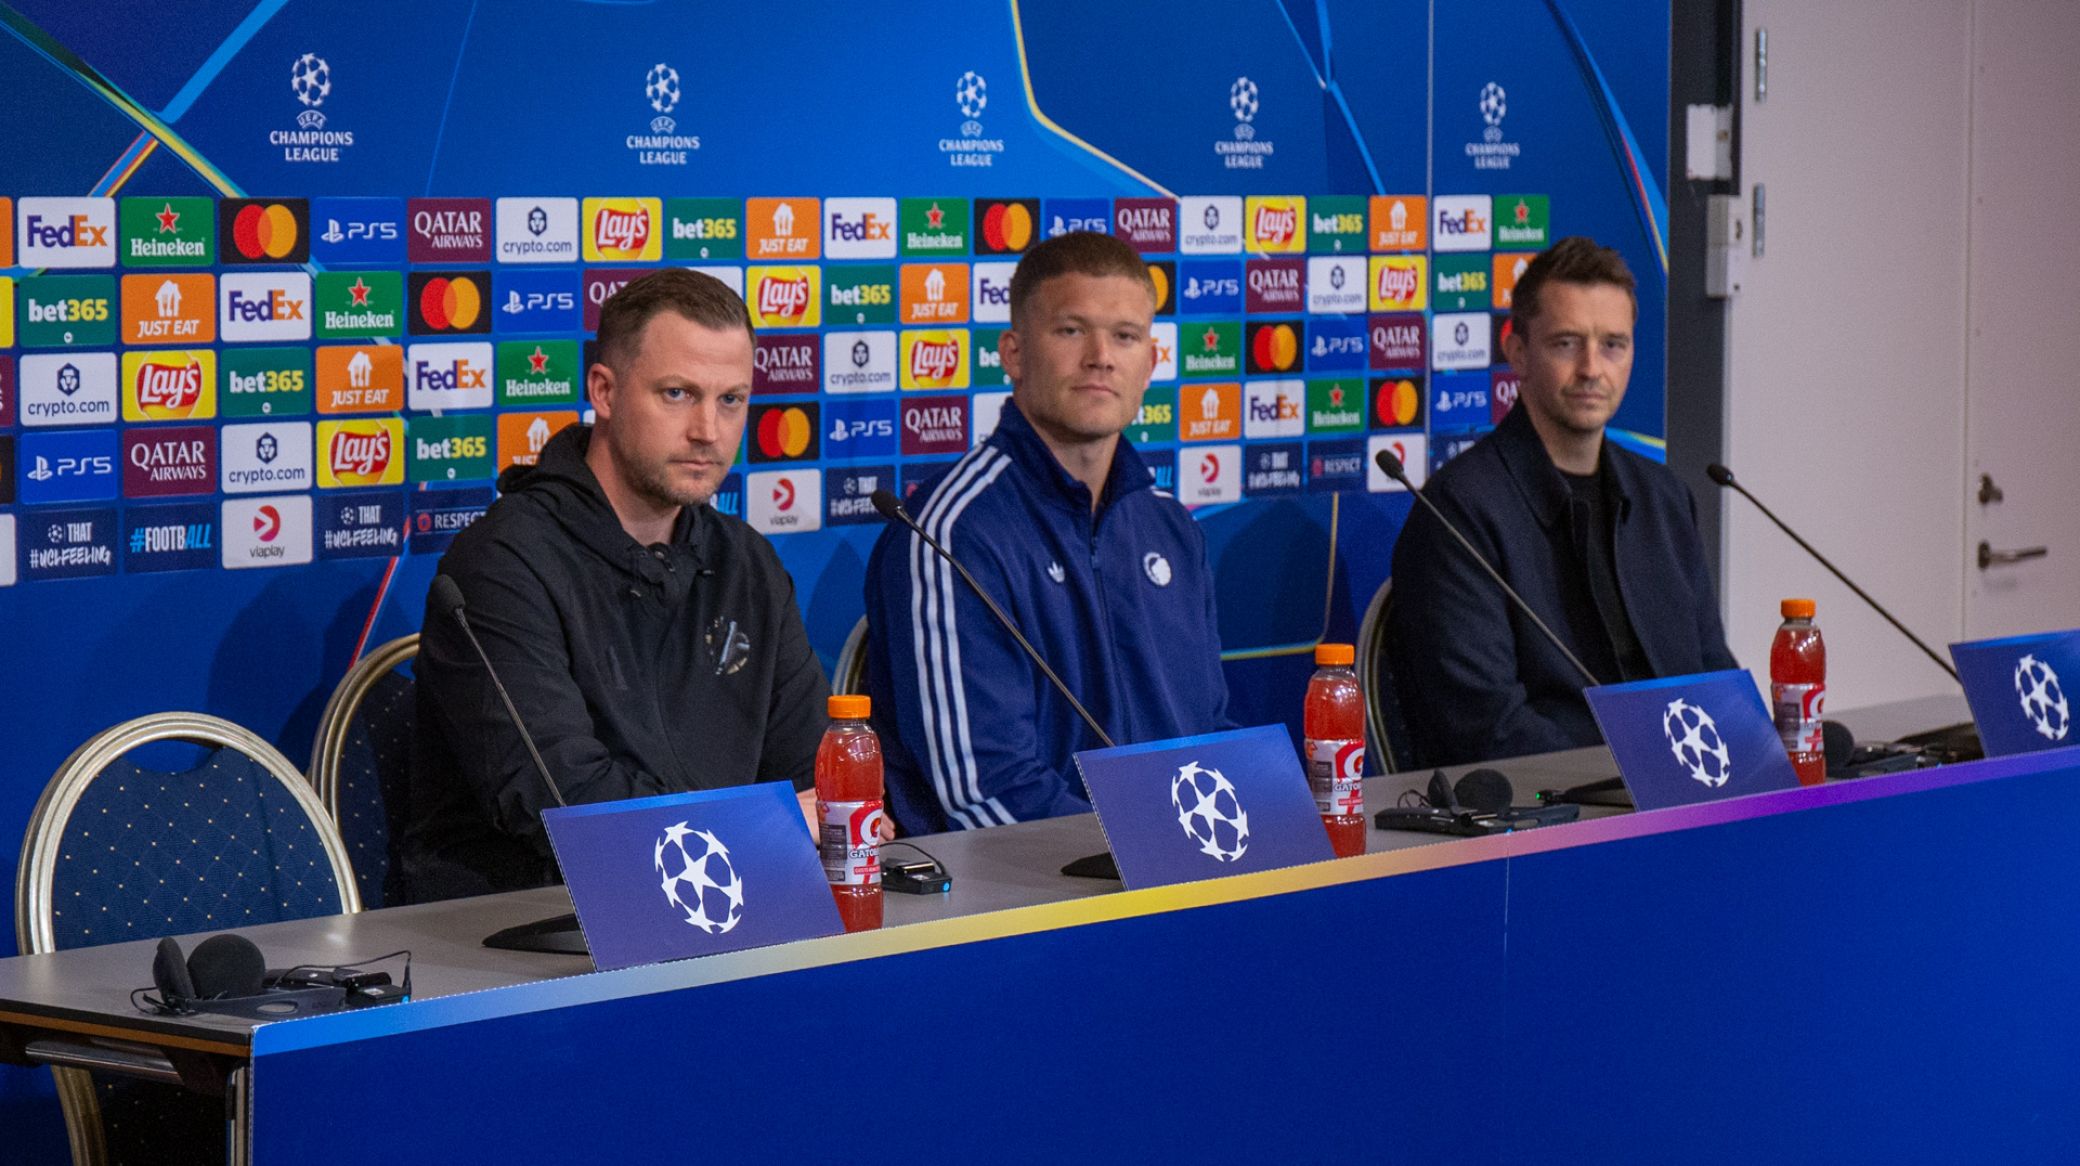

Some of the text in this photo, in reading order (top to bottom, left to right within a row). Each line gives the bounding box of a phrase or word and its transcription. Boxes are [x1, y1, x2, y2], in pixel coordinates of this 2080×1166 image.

[270, 131, 354, 145] CHAMPIONS
[626, 135, 700, 149] CHAMPIONS
[939, 139, 1004, 152] CHAMPIONS
[285, 147, 339, 161] LEAGUE
[640, 151, 687, 164] LEAGUE
[950, 154, 992, 166] LEAGUE
[414, 211, 482, 238] QATAR
[599, 209, 647, 250] Lay's
[673, 217, 736, 239] bet365
[832, 213, 889, 240] FedEx
[1118, 208, 1170, 233] QATAR
[1257, 207, 1294, 242] Lay's
[1313, 212, 1363, 233] bet365
[1439, 209, 1486, 235] FedEx
[28, 215, 107, 247] FedEx
[348, 222, 397, 239] PS5
[131, 238, 204, 256] Heineken
[432, 235, 483, 248] AIRWAYS
[503, 240, 572, 255] crypto.com
[759, 238, 808, 254] JUST EAT
[907, 232, 963, 249] Heineken
[1202, 279, 1239, 296] PS5
[1249, 268, 1298, 291] QATAR
[1438, 272, 1486, 292] bet365
[761, 277, 807, 316] Lay's
[831, 284, 890, 305] bet365
[980, 278, 1010, 304] Fed
[28, 299, 108, 322] bet365
[229, 290, 303, 322] FedEx
[527, 293, 574, 309] PS5
[912, 302, 958, 319] JUST EAT
[137, 320, 199, 337] JUST EAT
[325, 311, 393, 329] Heineken
[1329, 336, 1364, 353] PS5
[1373, 326, 1420, 349] QATAR
[754, 346, 812, 374] QATAR
[914, 341, 956, 379] Lay's
[1186, 354, 1236, 371] Heineken
[230, 370, 304, 393] bet365
[416, 360, 486, 390] FedEx
[768, 368, 813, 382] AIRWAYS
[830, 372, 891, 386] crypto.com
[140, 365, 198, 408] Lay's
[506, 379, 571, 397] Heineken
[331, 389, 389, 407] JUST EAT
[28, 399, 110, 417] crypto.com
[1138, 404, 1172, 425] t365
[1250, 395, 1299, 421] FedEx
[852, 420, 893, 436] PS5
[906, 406, 962, 432] QATAR
[131, 441, 205, 470] QATAR
[334, 433, 387, 475] Lay's
[417, 437, 486, 459] bet365
[57, 457, 111, 475] PS5
[150, 465, 206, 481] AIRWAYS
[229, 467, 305, 485] crypto.com
[358, 505, 381, 523] THAT
[67, 522, 92, 542] THAT
[129, 524, 211, 553] #FOOTBALL
[325, 529, 397, 548] #UCLFEELING
[29, 545, 111, 568] #UCLFEELING
[249, 545, 285, 558] viaplay
